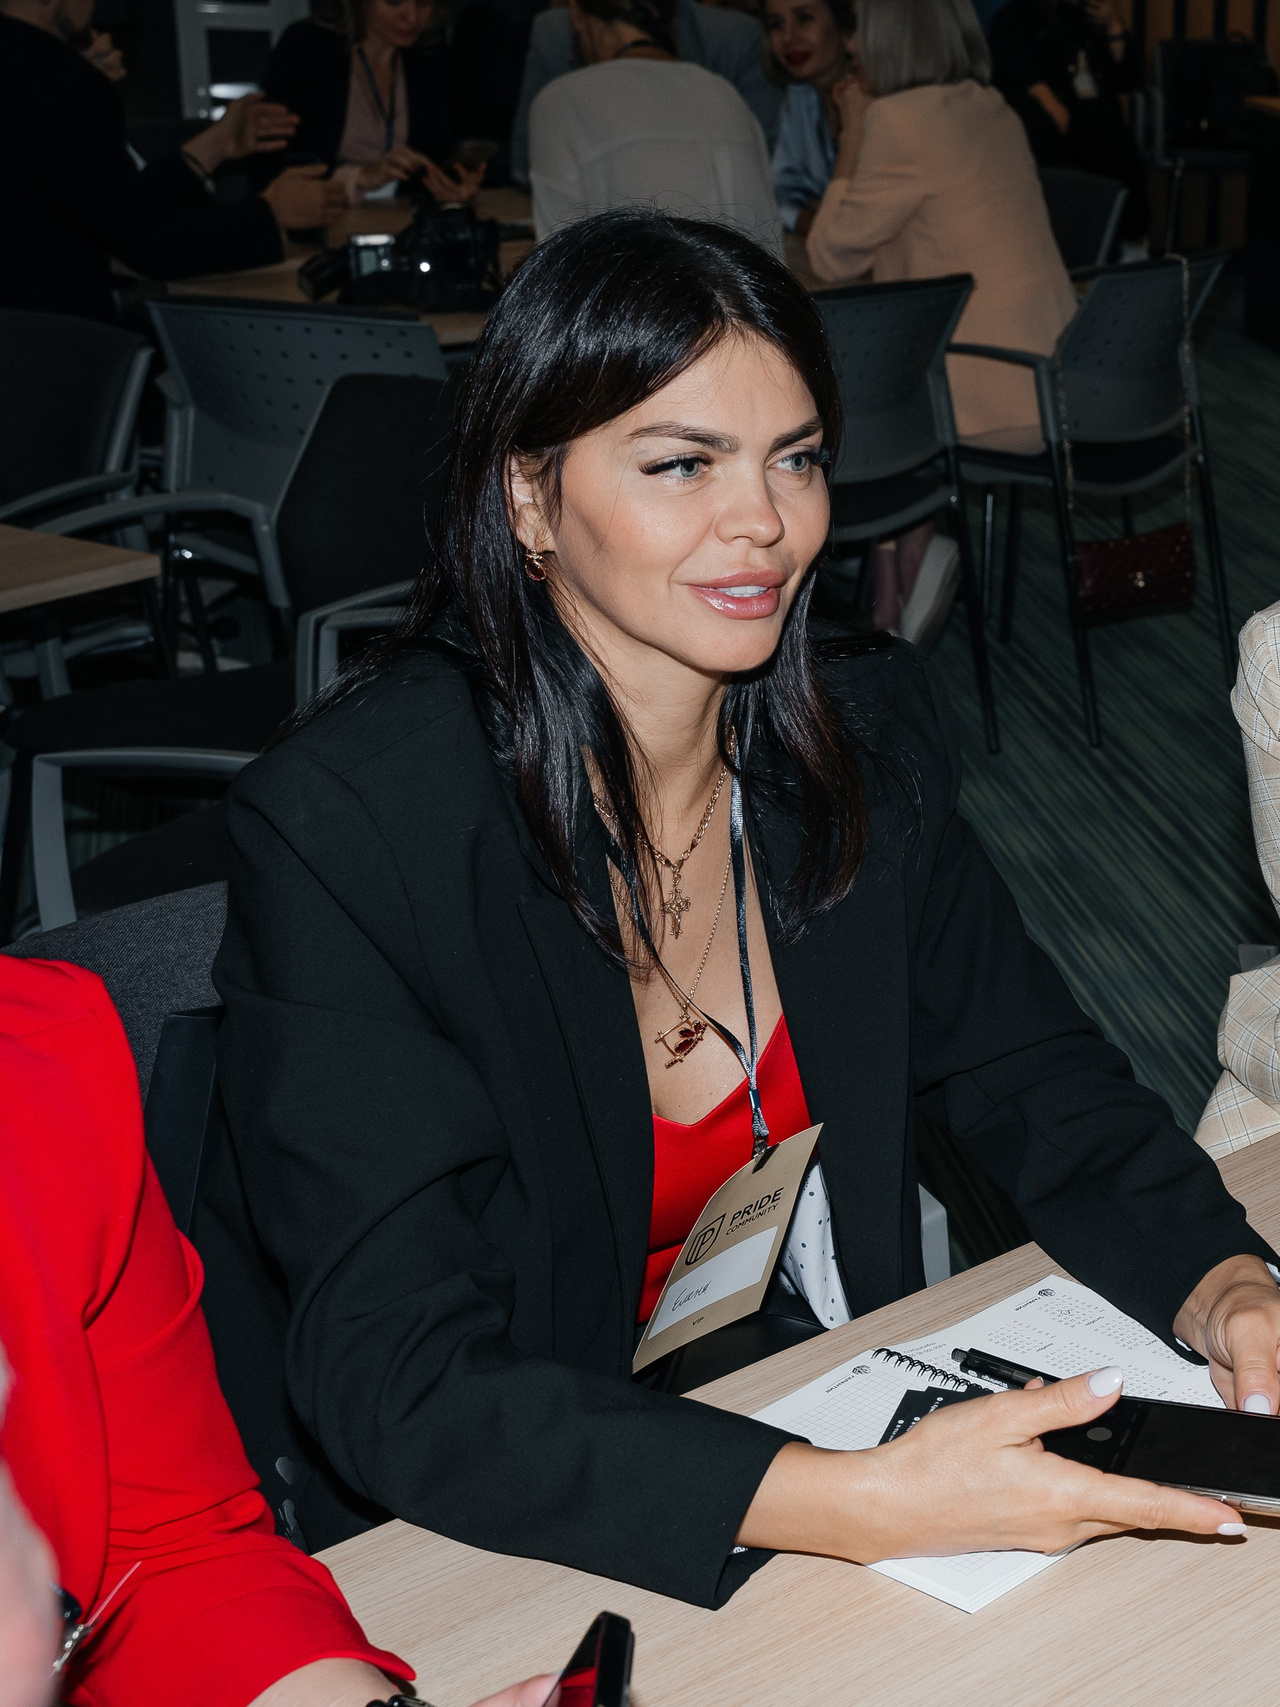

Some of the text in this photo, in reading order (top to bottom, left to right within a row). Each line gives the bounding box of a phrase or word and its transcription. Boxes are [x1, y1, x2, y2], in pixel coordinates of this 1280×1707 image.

[726, 1203, 779, 1235] COMMUNITY
[729, 1186, 784, 1226] PRIDE
[692, 1316, 705, 1326] VIP
